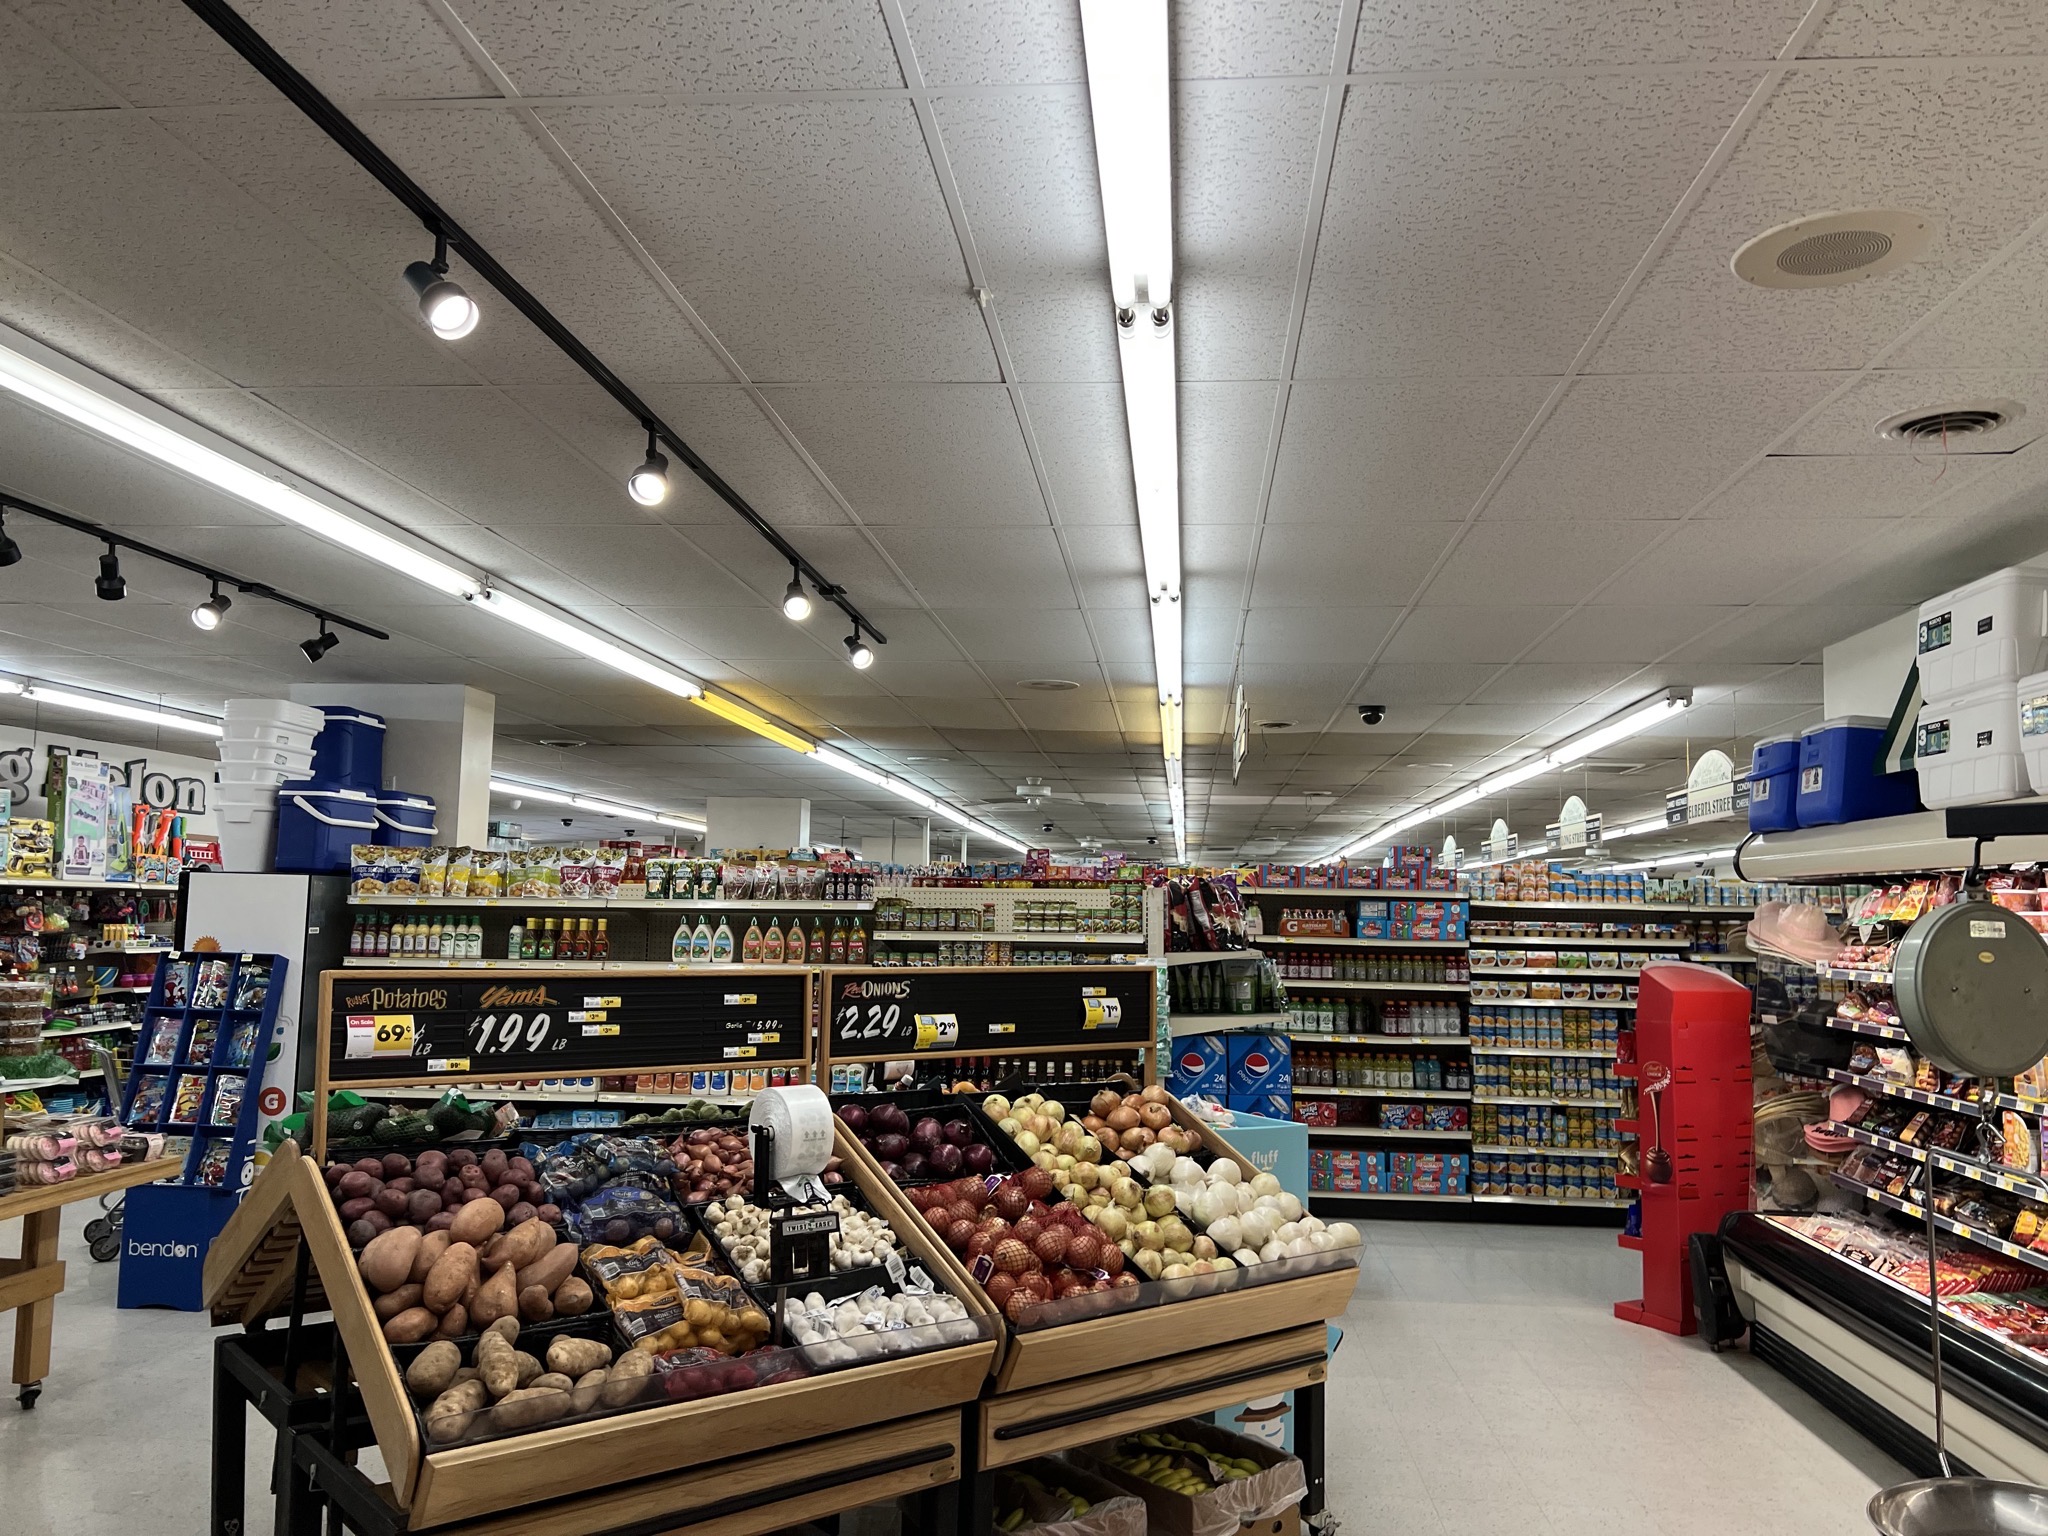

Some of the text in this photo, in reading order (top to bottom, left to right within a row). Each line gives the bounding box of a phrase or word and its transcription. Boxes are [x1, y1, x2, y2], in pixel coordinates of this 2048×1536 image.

[1920, 626, 1928, 643] 3
[1918, 730, 1926, 746] 3
[1689, 801, 1711, 819] ELBERTA
[1287, 921, 1298, 932] G
[863, 980, 911, 999] ONIONS
[371, 987, 447, 1010] Potatoes
[415, 1043, 433, 1056] LB
[551, 1038, 568, 1050] LB
[1237, 1069, 1254, 1086] pepsi
[264, 1093, 279, 1110] G
[786, 1223, 807, 1232] TWIST
[128, 1239, 198, 1258] bendon
